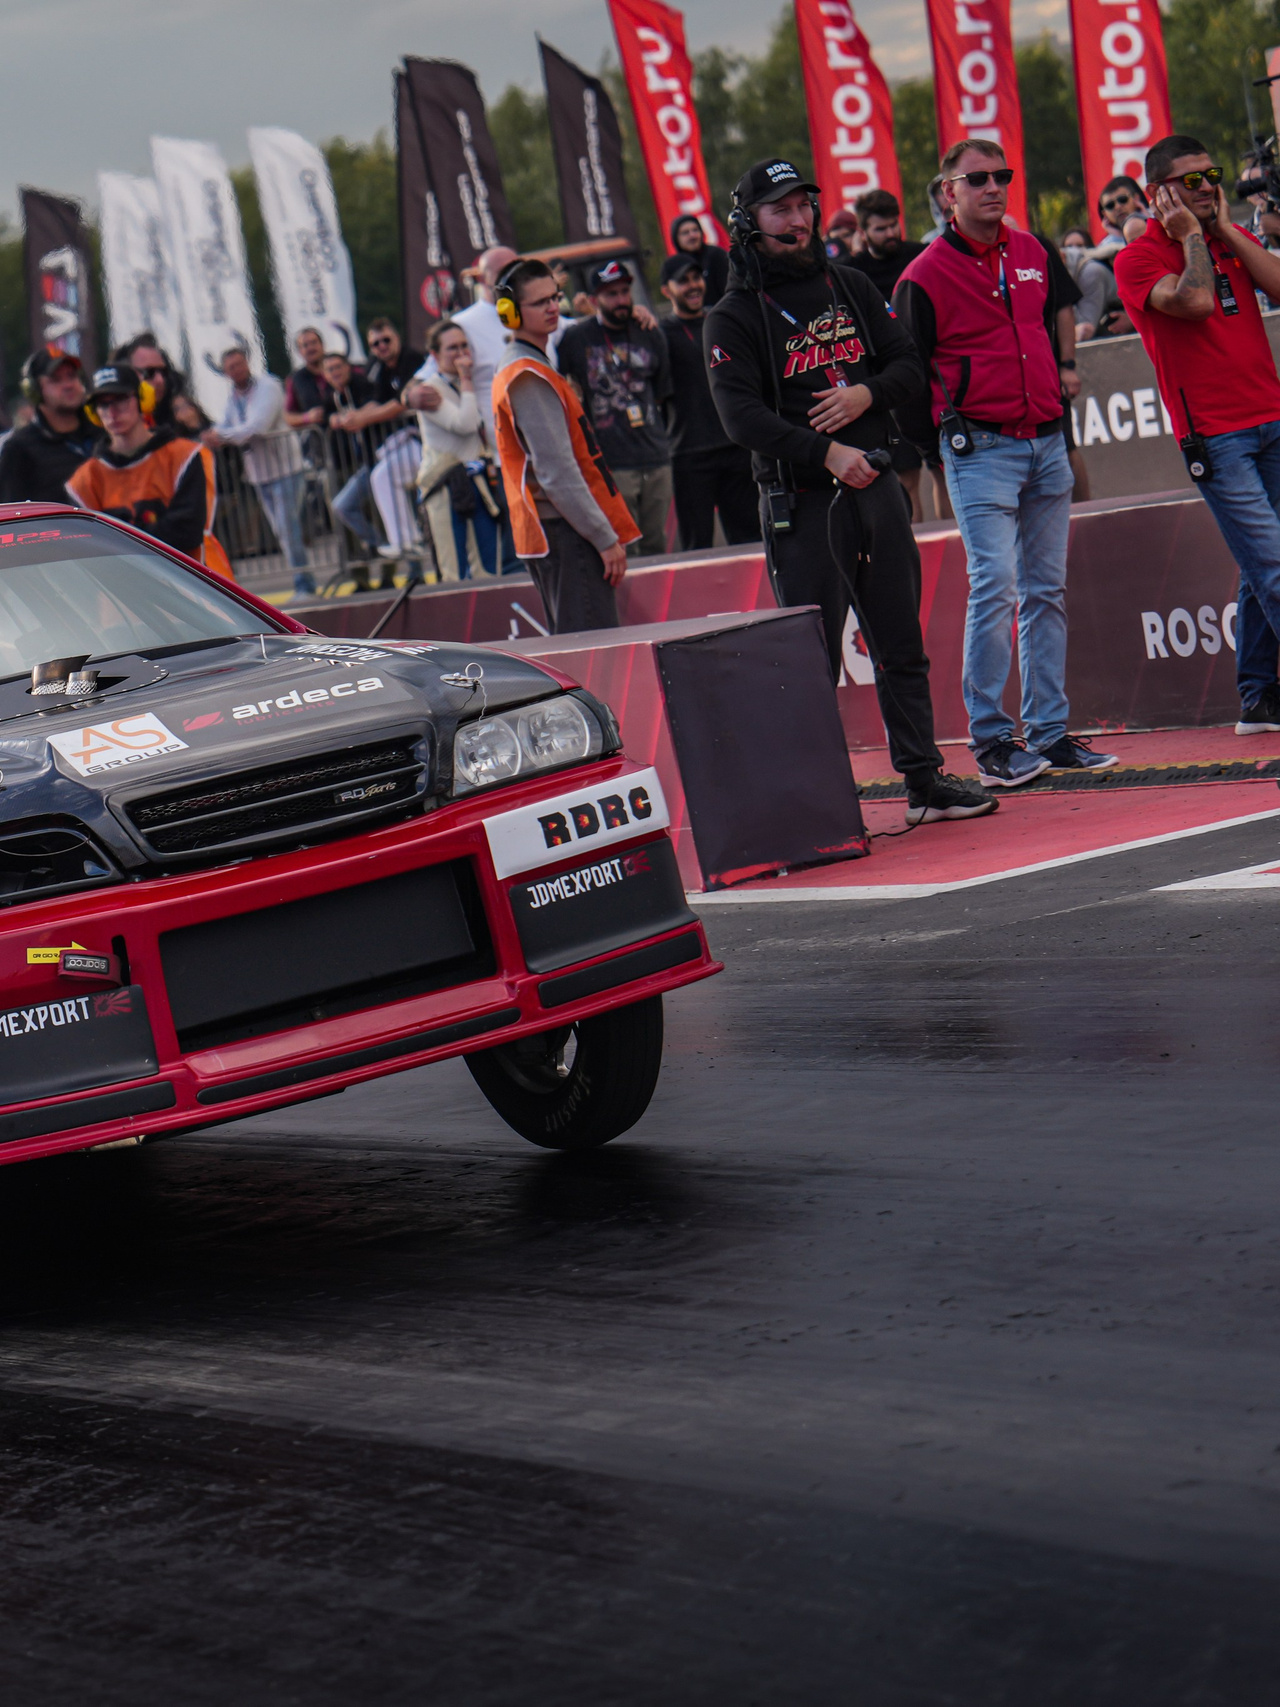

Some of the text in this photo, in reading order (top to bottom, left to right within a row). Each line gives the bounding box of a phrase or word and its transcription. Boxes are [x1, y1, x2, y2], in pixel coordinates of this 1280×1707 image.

[819, 1, 881, 212] uto.ru
[766, 163, 794, 177] RDRC
[232, 677, 384, 719] ardeca
[236, 700, 336, 726] lubricants
[69, 713, 167, 766] AS
[86, 743, 180, 774] GROUP
[537, 786, 652, 848] RDRC
[527, 858, 623, 909] JDMEXPORT
[69, 958, 106, 970] sparco
